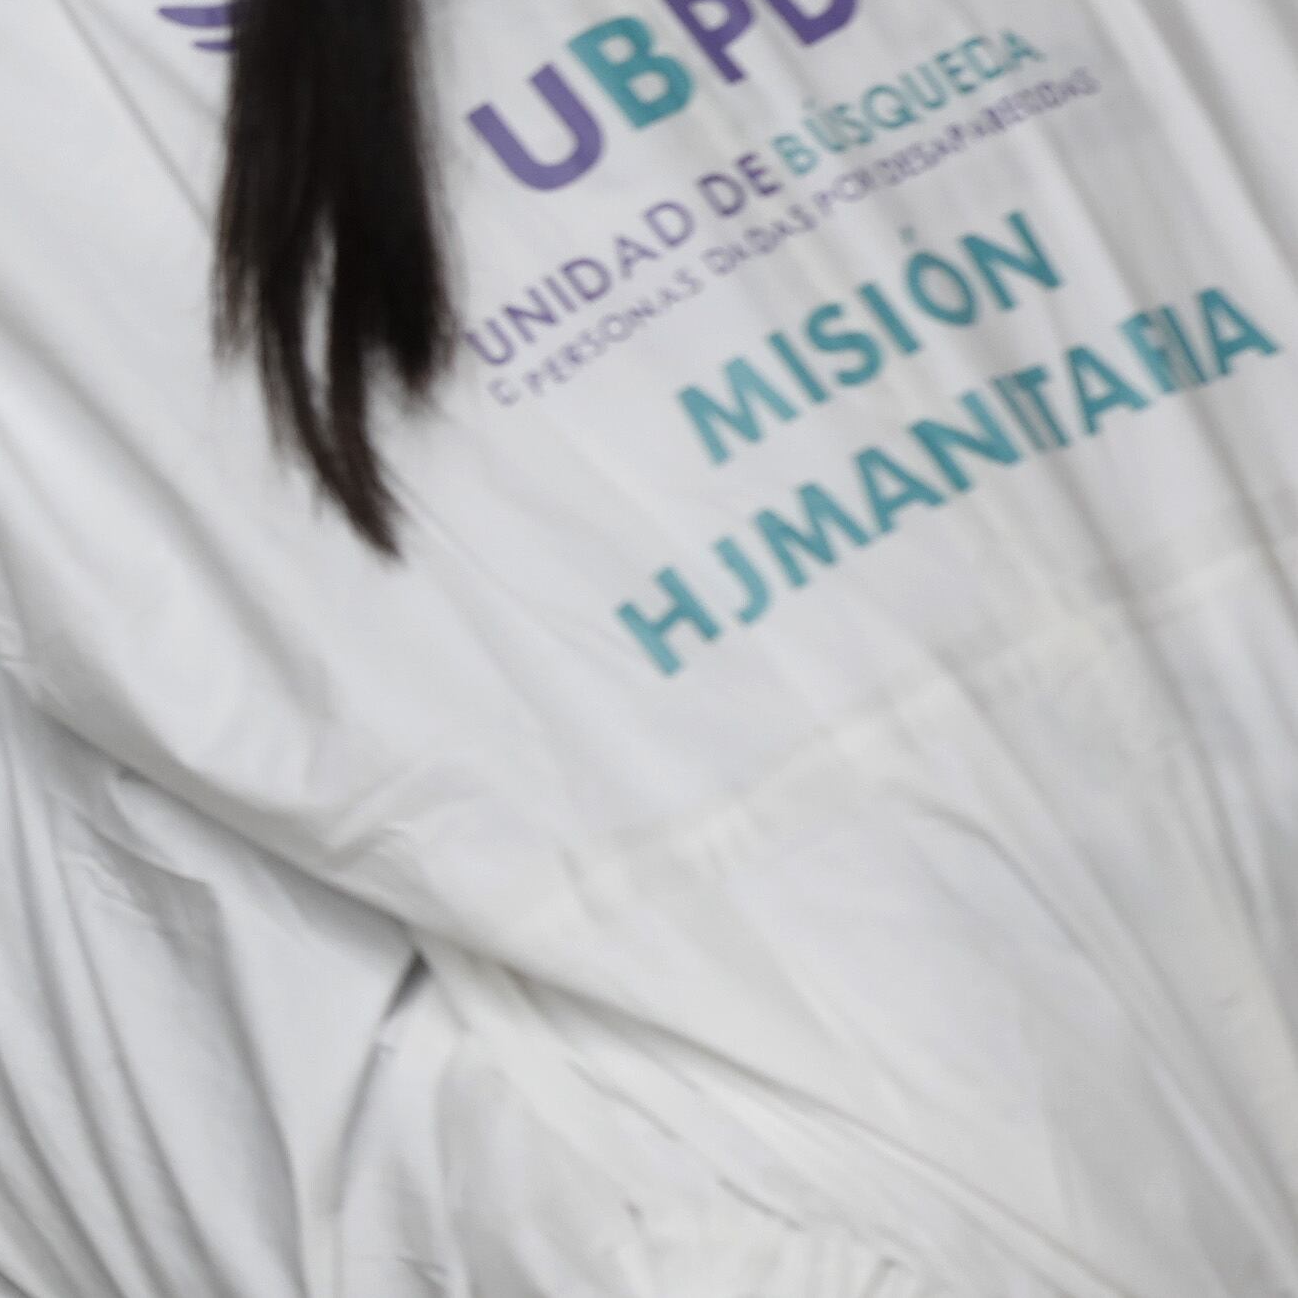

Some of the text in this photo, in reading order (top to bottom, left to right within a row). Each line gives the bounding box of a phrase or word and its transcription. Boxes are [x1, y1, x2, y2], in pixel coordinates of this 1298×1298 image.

[462, 199, 696, 366] UNIDAD
[697, 152, 783, 217] DE
[677, 210, 1064, 467] MISIÓN
